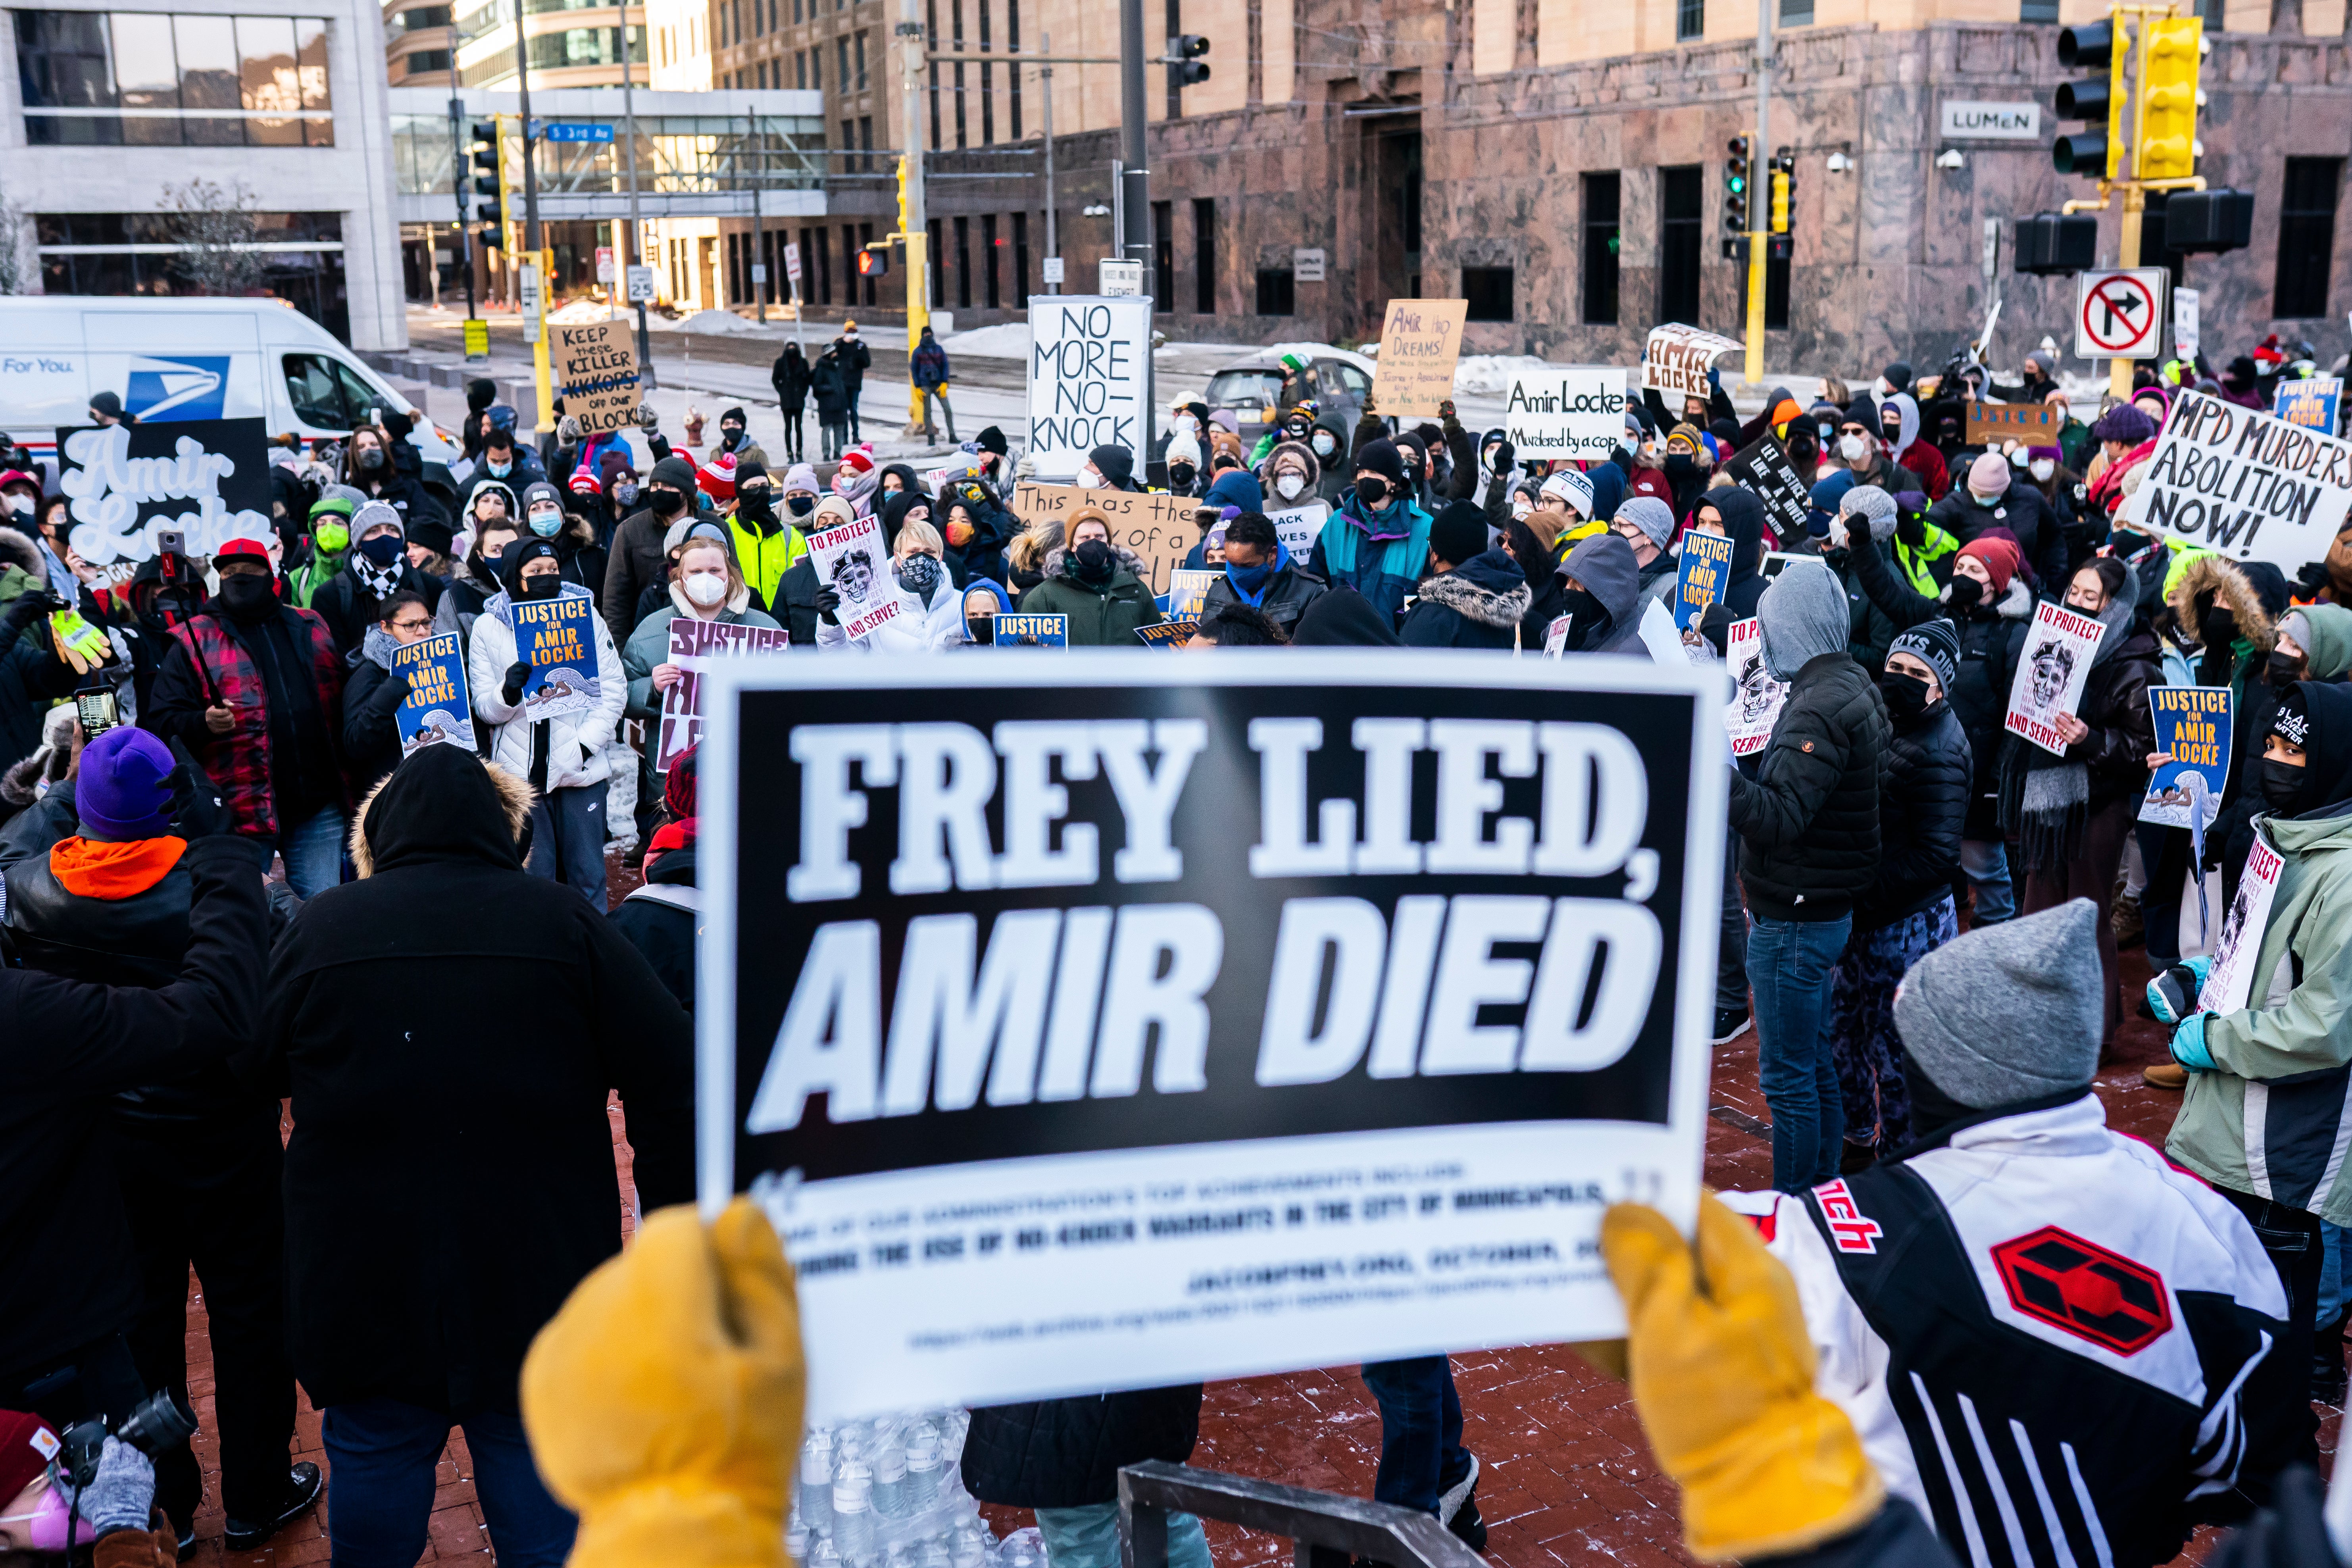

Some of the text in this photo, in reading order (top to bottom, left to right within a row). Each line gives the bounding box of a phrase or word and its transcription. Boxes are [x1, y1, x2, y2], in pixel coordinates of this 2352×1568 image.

[1952, 110, 2030, 129] LUMEN
[568, 127, 588, 139] 3rd
[632, 283, 652, 296] 25
[1062, 305, 1111, 339] NO
[562, 326, 608, 347] KEEP
[575, 344, 613, 356] these
[1035, 340, 1131, 381] MORE
[1650, 339, 1712, 373] AMIR
[3, 358, 35, 374] For
[567, 351, 631, 375] KILLER
[566, 370, 635, 399] KKKOPS
[1649, 366, 1708, 395] LOCKE
[2283, 382, 2335, 396] JUSTICE
[1055, 381, 1133, 415] NO-
[1508, 380, 1624, 415] Amir Locke
[2289, 399, 2325, 412] AMIR
[1970, 404, 2027, 424] JUSTICE
[2283, 410, 2327, 427] LOCKE
[1031, 416, 1135, 452] KNOCK
[1567, 427, 1579, 454] by
[1581, 437, 1590, 447] a
[2167, 393, 2352, 490] MPD MURDERS
[60, 424, 235, 503] Amir
[967, 467, 979, 477] M
[1761, 443, 1807, 500] LET JUSTICE
[2148, 441, 2322, 525] ABOLITION
[1018, 487, 1192, 522] This has the
[1773, 486, 1785, 498] A
[1783, 498, 1807, 526] RIVER
[68, 493, 279, 566] Locke
[808, 516, 876, 552] TO PROTECT
[2145, 487, 2266, 557] NOW!
[1169, 535, 1183, 549] a
[1278, 532, 1308, 542] VES
[1685, 533, 1729, 563] JUSTICE
[1698, 556, 1711, 568] FOR
[1176, 573, 1219, 590] JUSTI
[1687, 566, 1717, 591] AMIR
[1183, 598, 1204, 614] AM
[1683, 583, 1716, 607] LOCKE
[518, 600, 588, 625] JUSTICE
[846, 601, 900, 639] AND SERVE?
[2038, 603, 2103, 643] TO PROTECT
[546, 620, 562, 630] FOR
[1000, 617, 1062, 635] JUSTICE
[1731, 623, 1745, 643] TO
[534, 627, 579, 649] AMIR
[395, 636, 456, 668] JUSTICE
[531, 643, 585, 667] LOCKE
[408, 665, 449, 689] AMIR
[417, 660, 432, 670] FOR
[406, 682, 457, 710] LOCKE
[2158, 690, 2228, 714] JUSTICE
[2187, 711, 2202, 722] FOR
[2277, 707, 2309, 734] BLAC
[2283, 718, 2303, 735] LIVES
[2006, 711, 2067, 754] AND SERVE?
[2175, 721, 2216, 745] AMIR
[2275, 721, 2303, 745] MATTER
[2170, 742, 2220, 767] LOCKE
[787, 716, 1660, 903] FREY LIED,
[2245, 877, 2262, 900] FREY
[2208, 979, 2229, 1000] FREY
[744, 893, 1664, 1137] AMIR DIED
